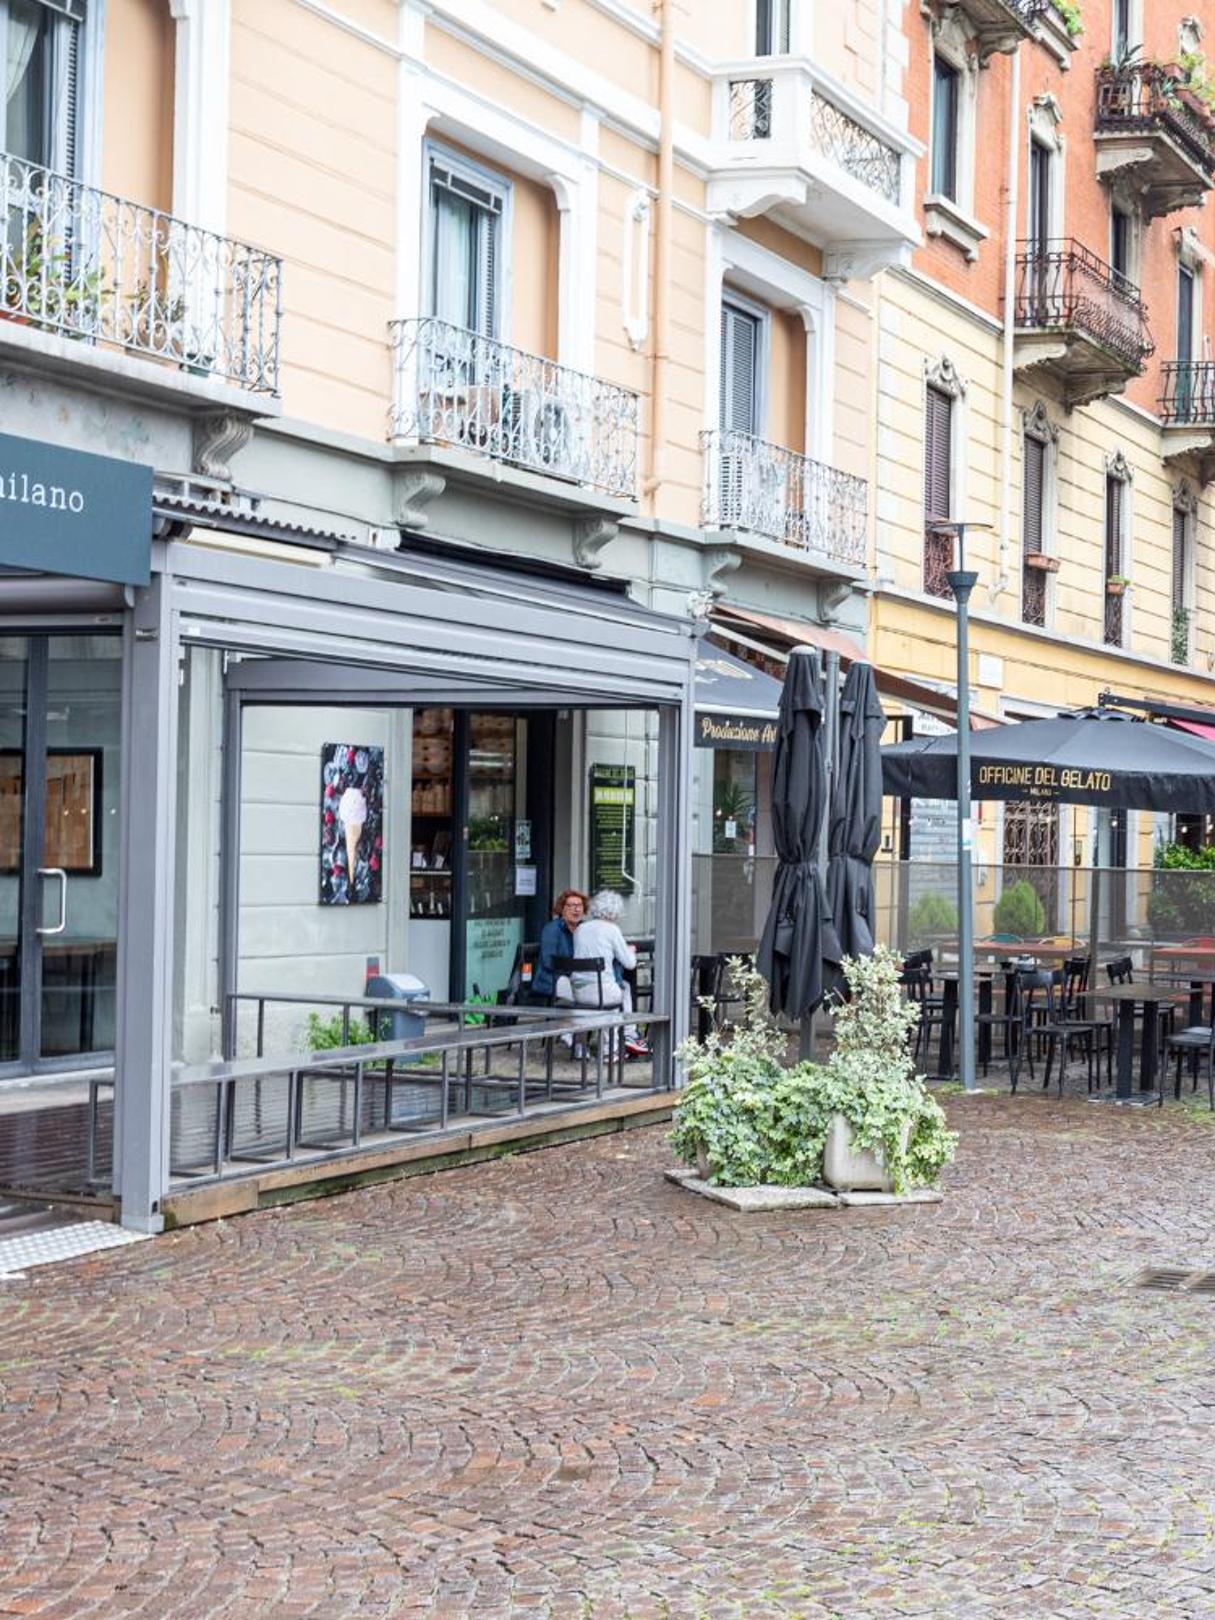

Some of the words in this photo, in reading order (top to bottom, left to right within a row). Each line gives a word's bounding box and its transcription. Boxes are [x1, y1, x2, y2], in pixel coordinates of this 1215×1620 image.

[702, 717, 760, 742] Produzione
[979, 766, 1032, 785] OFFICINE
[1034, 767, 1058, 786] DEL
[1060, 769, 1111, 791] GELATO
